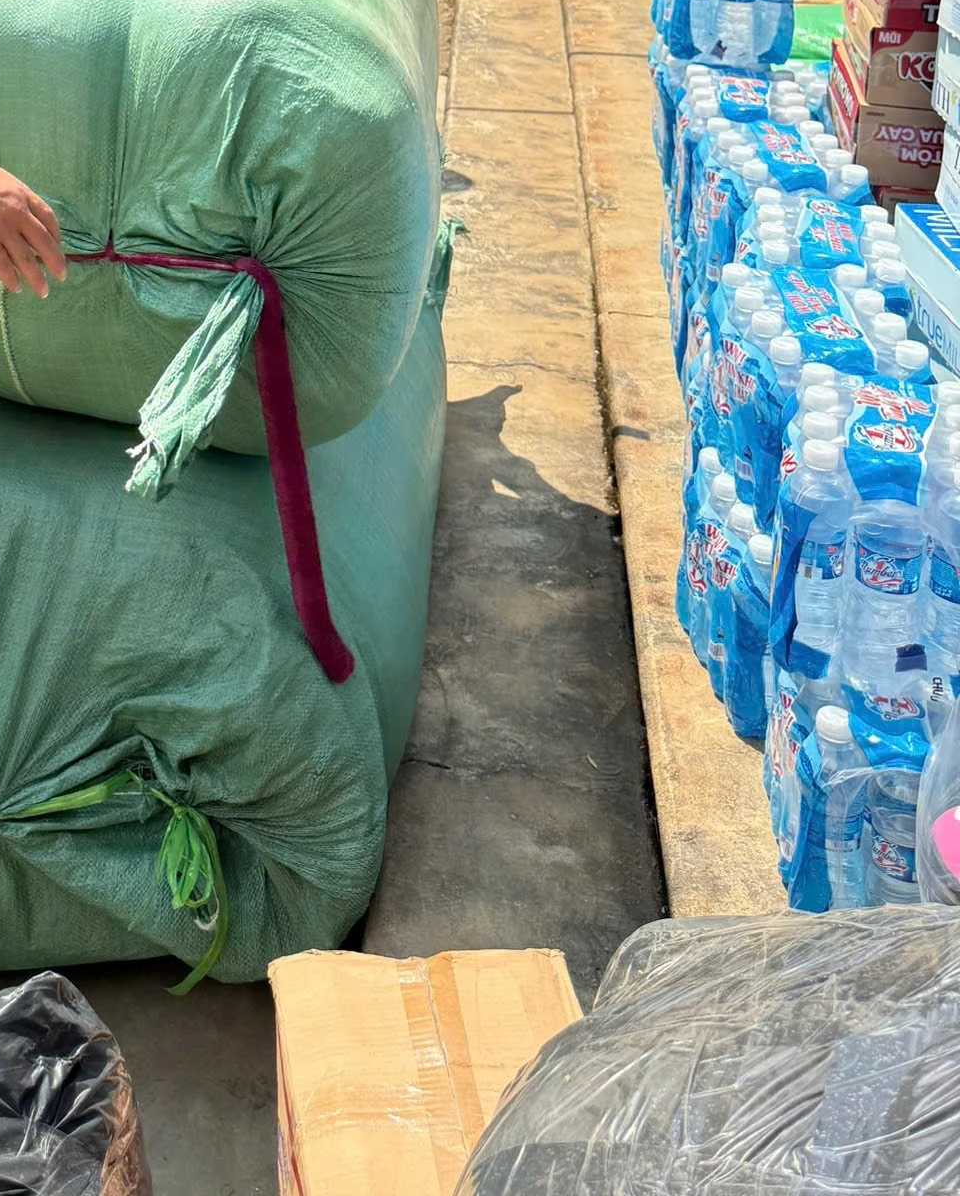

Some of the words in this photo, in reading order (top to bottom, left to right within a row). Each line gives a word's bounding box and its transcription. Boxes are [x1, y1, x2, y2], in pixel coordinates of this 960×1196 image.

[876, 128, 916, 142] CAY
[917, 294, 944, 350] true
[859, 557, 905, 579] Number
